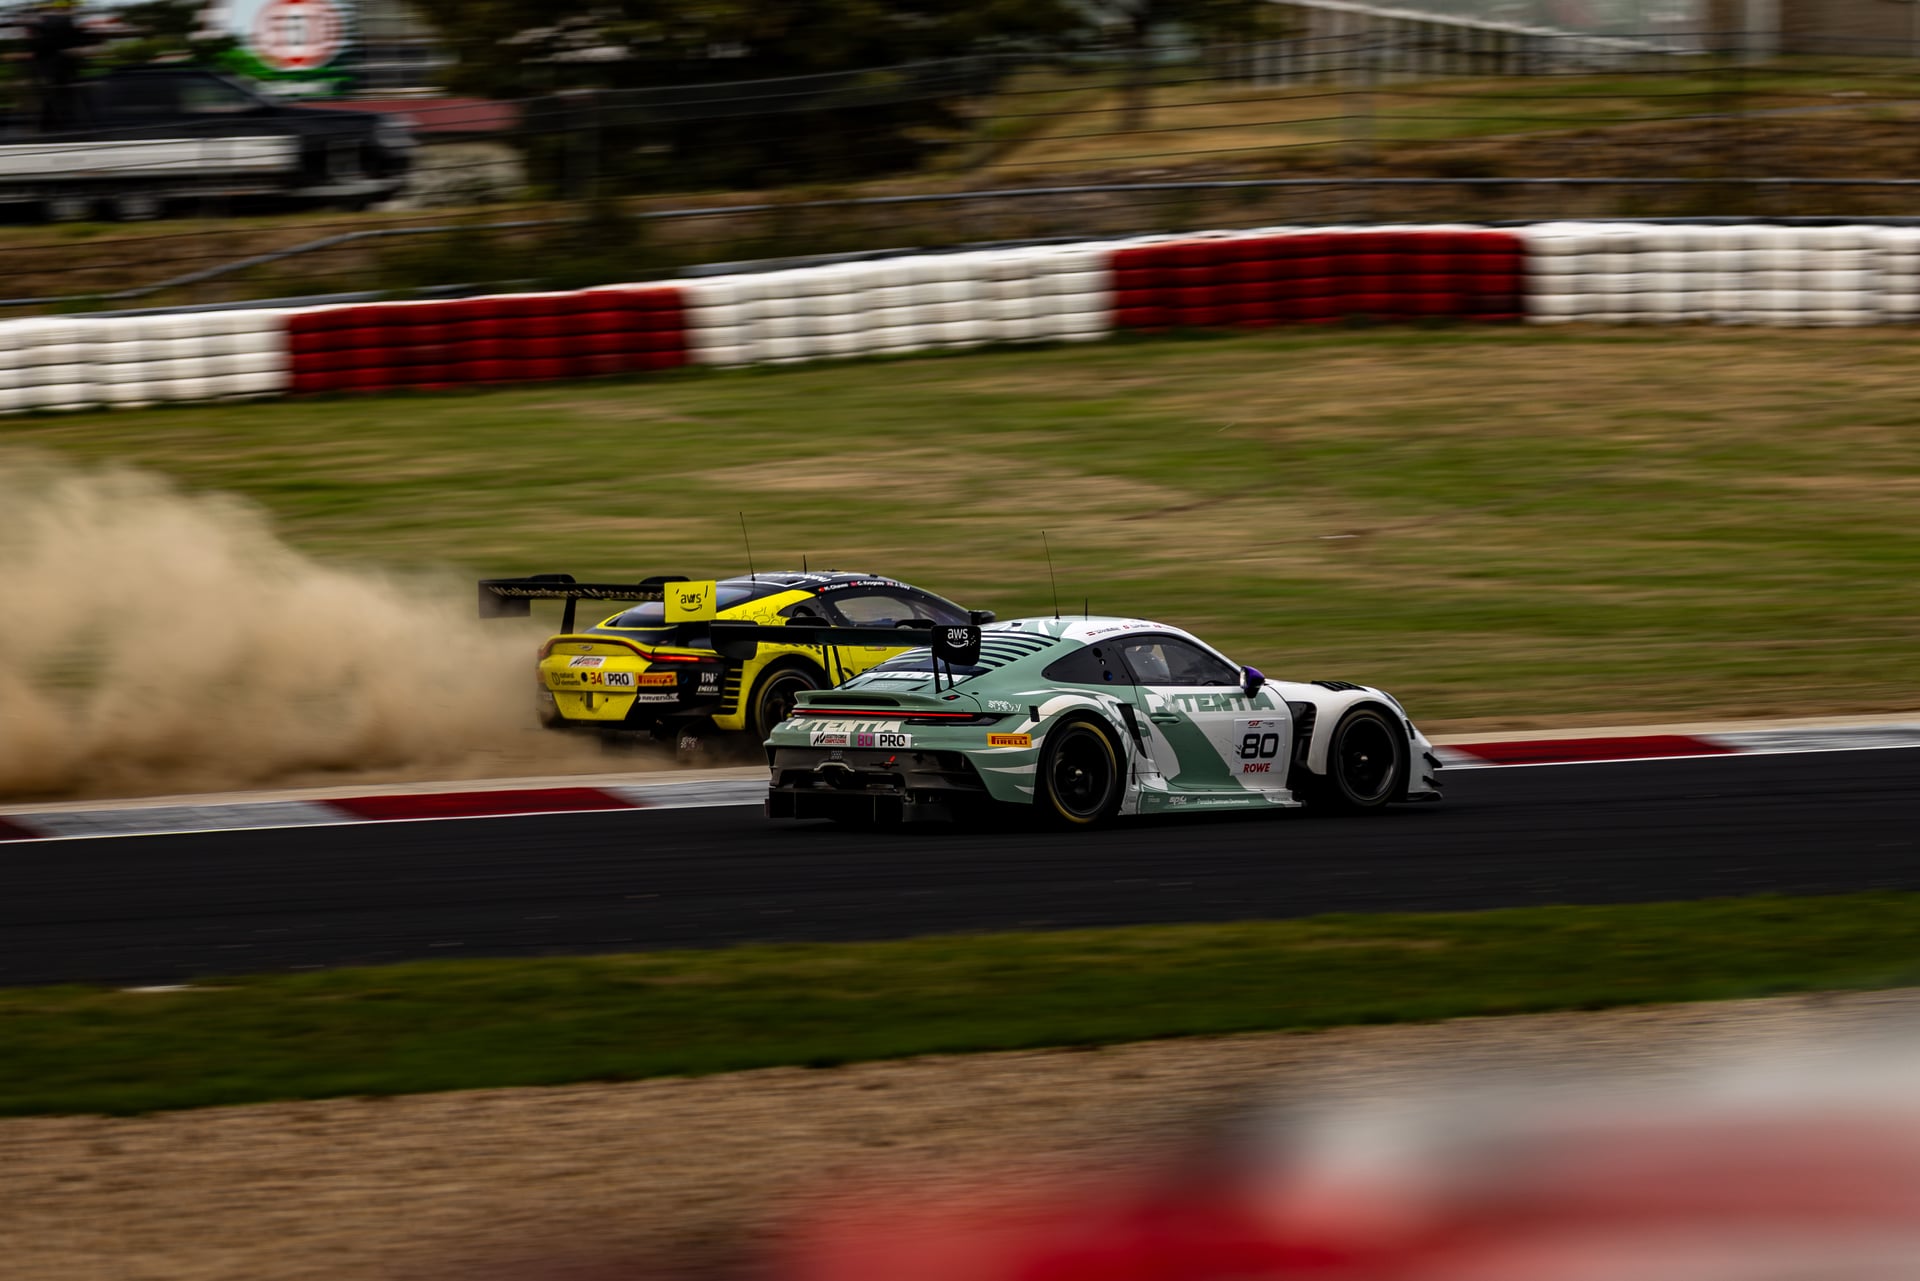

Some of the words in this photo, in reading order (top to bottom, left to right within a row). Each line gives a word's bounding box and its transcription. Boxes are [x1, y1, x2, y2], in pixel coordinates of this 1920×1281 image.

[680, 593, 702, 604] aws
[947, 628, 969, 639] aws
[590, 671, 603, 685] 34
[607, 673, 630, 686] PRO
[638, 674, 674, 685] PIRELLI
[1144, 692, 1276, 713] PTENTIA
[857, 733, 873, 747] 80
[879, 734, 906, 747] PRO
[991, 735, 1028, 745] PIRELLI
[1240, 733, 1279, 759] 80
[1243, 763, 1271, 773] ROWE
